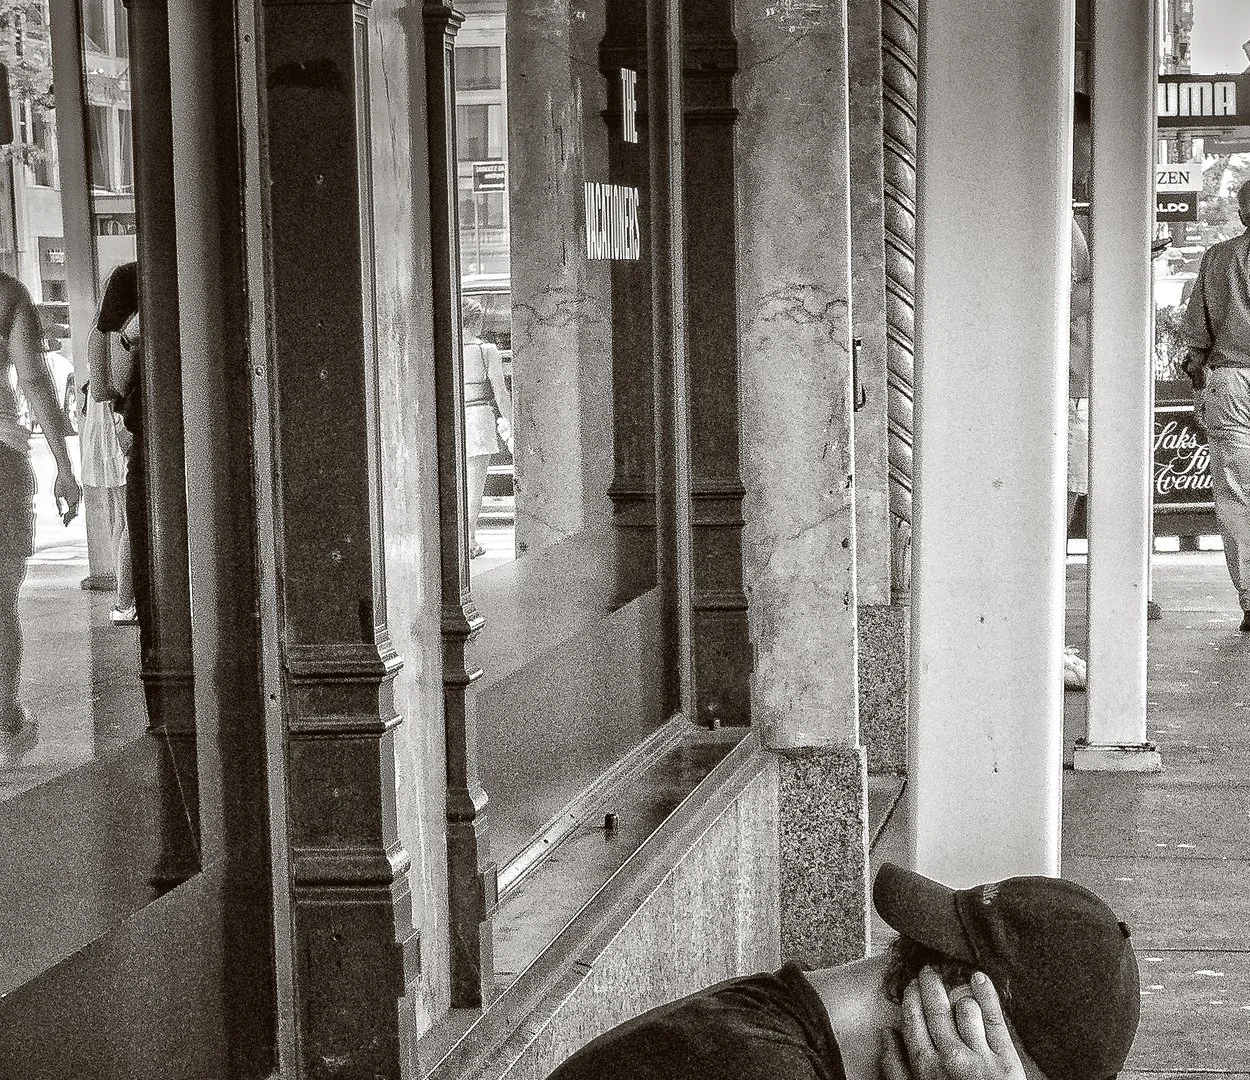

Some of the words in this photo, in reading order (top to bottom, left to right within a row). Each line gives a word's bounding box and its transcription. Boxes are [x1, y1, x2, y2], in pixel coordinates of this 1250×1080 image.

[621, 67, 638, 143] THE
[1157, 81, 1237, 117] UMA
[584, 182, 640, 260] VACATIONERS
